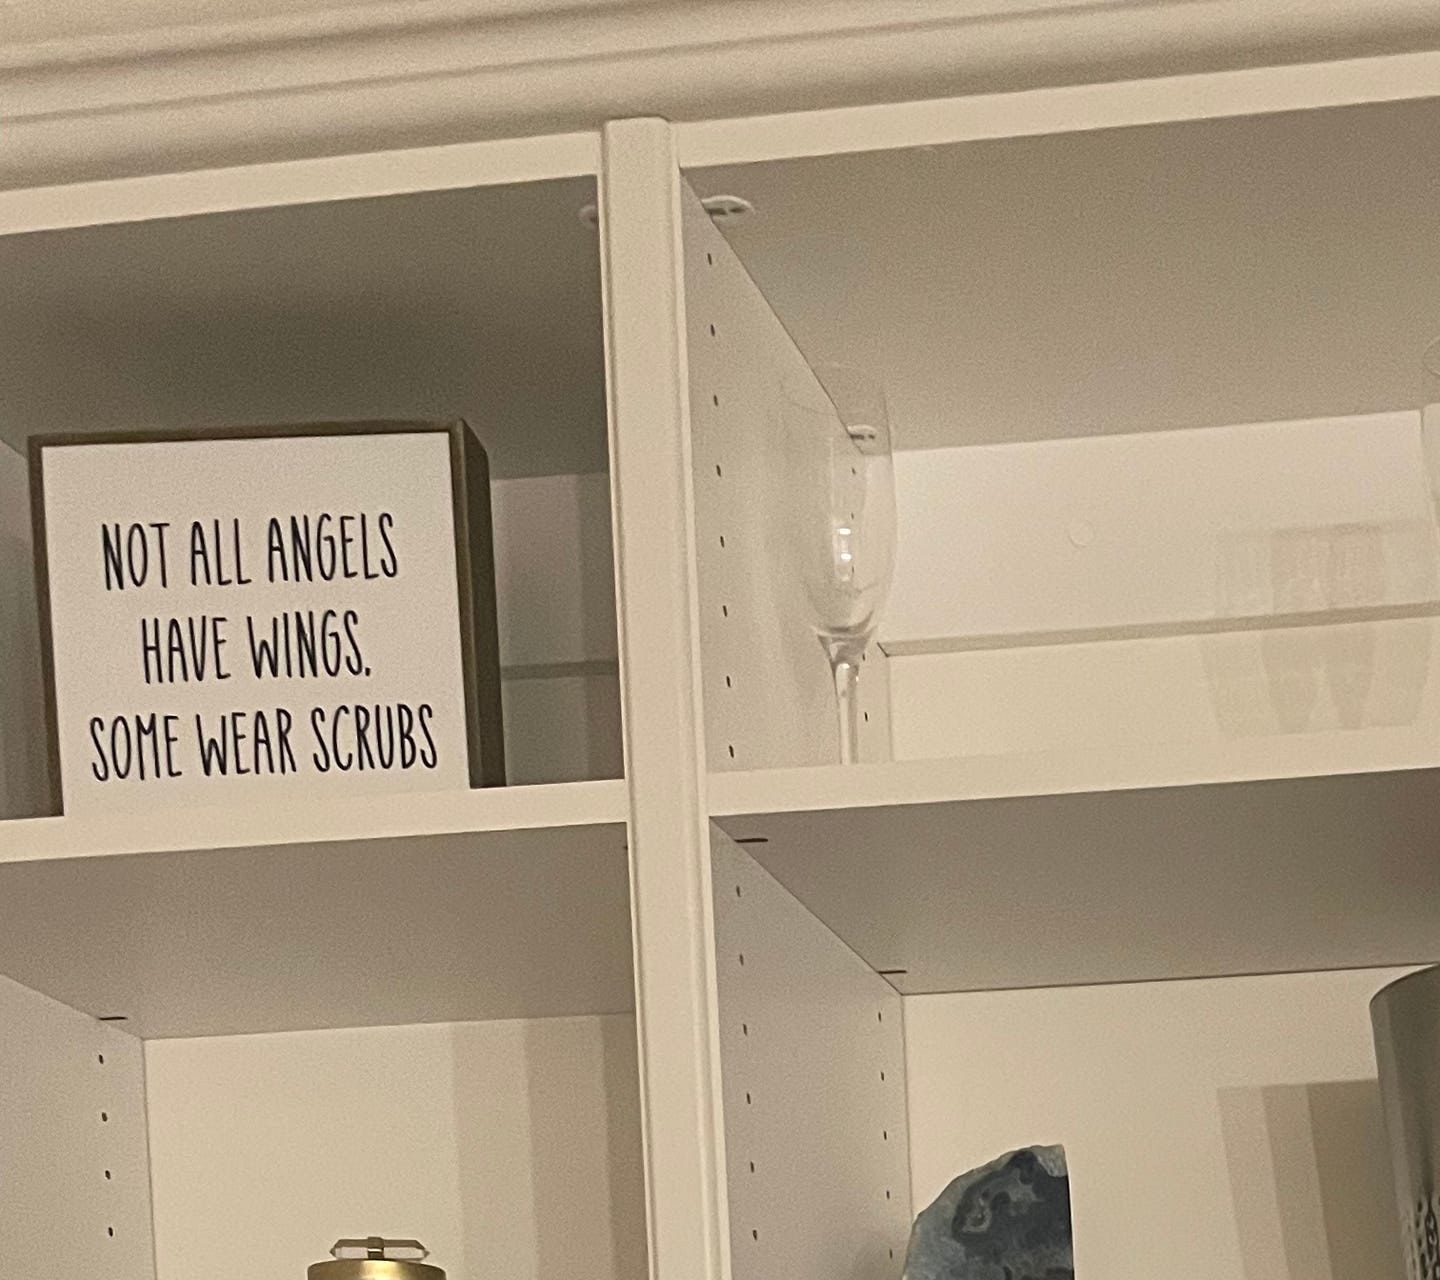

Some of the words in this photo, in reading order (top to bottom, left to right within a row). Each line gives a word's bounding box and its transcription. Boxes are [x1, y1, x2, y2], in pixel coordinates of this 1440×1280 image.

[101, 522, 171, 591] NOT
[190, 518, 253, 586] ALL
[268, 512, 399, 583] ANGELS
[141, 615, 232, 684] HAVE
[247, 609, 372, 679] WINGS.
[90, 712, 183, 781] SOME
[197, 708, 297, 776] WEAR
[310, 703, 439, 772] SCRUBS
